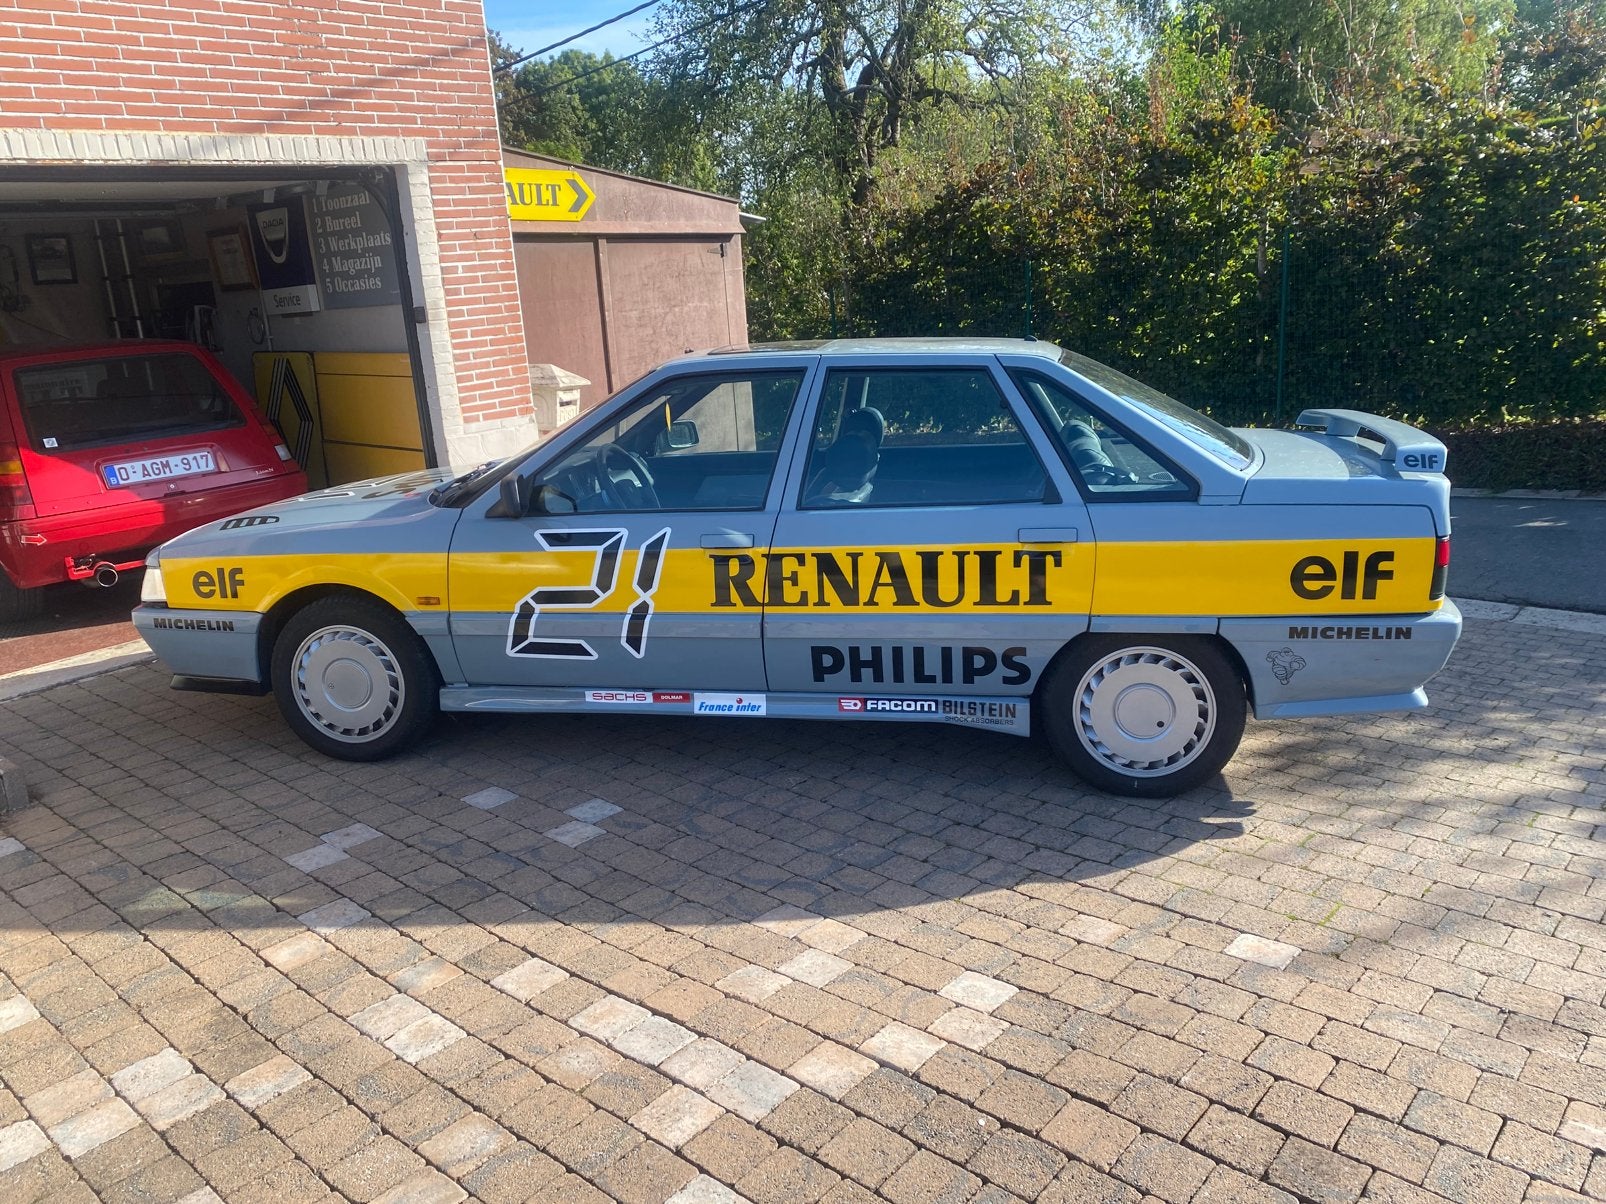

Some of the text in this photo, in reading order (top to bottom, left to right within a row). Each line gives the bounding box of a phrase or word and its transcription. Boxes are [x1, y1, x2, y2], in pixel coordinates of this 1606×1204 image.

[312, 190, 370, 213] 1 Toonzaal
[262, 218, 284, 229] DACIA
[315, 211, 361, 233] 2 Bureel
[318, 231, 391, 254] 3 Werkplaats
[322, 253, 382, 275] 4 Magazijn
[325, 275, 382, 293] 5 Occasies
[273, 292, 301, 308] Service
[1403, 453, 1438, 469] elf
[110, 477, 118, 485] B
[192, 567, 245, 599] elf
[709, 550, 1063, 607] RENAULT
[1289, 551, 1394, 600] elf
[505, 526, 672, 660] 21
[153, 617, 235, 632] MICHELIN
[1288, 626, 1412, 640] MICHELIN
[810, 645, 1032, 686] PHILIPS
[698, 696, 761, 712] France inter
[866, 700, 936, 711] FACOM
[942, 700, 1016, 718] BILSTEIN
[944, 715, 1014, 726] SHOCK ABSORBERS
